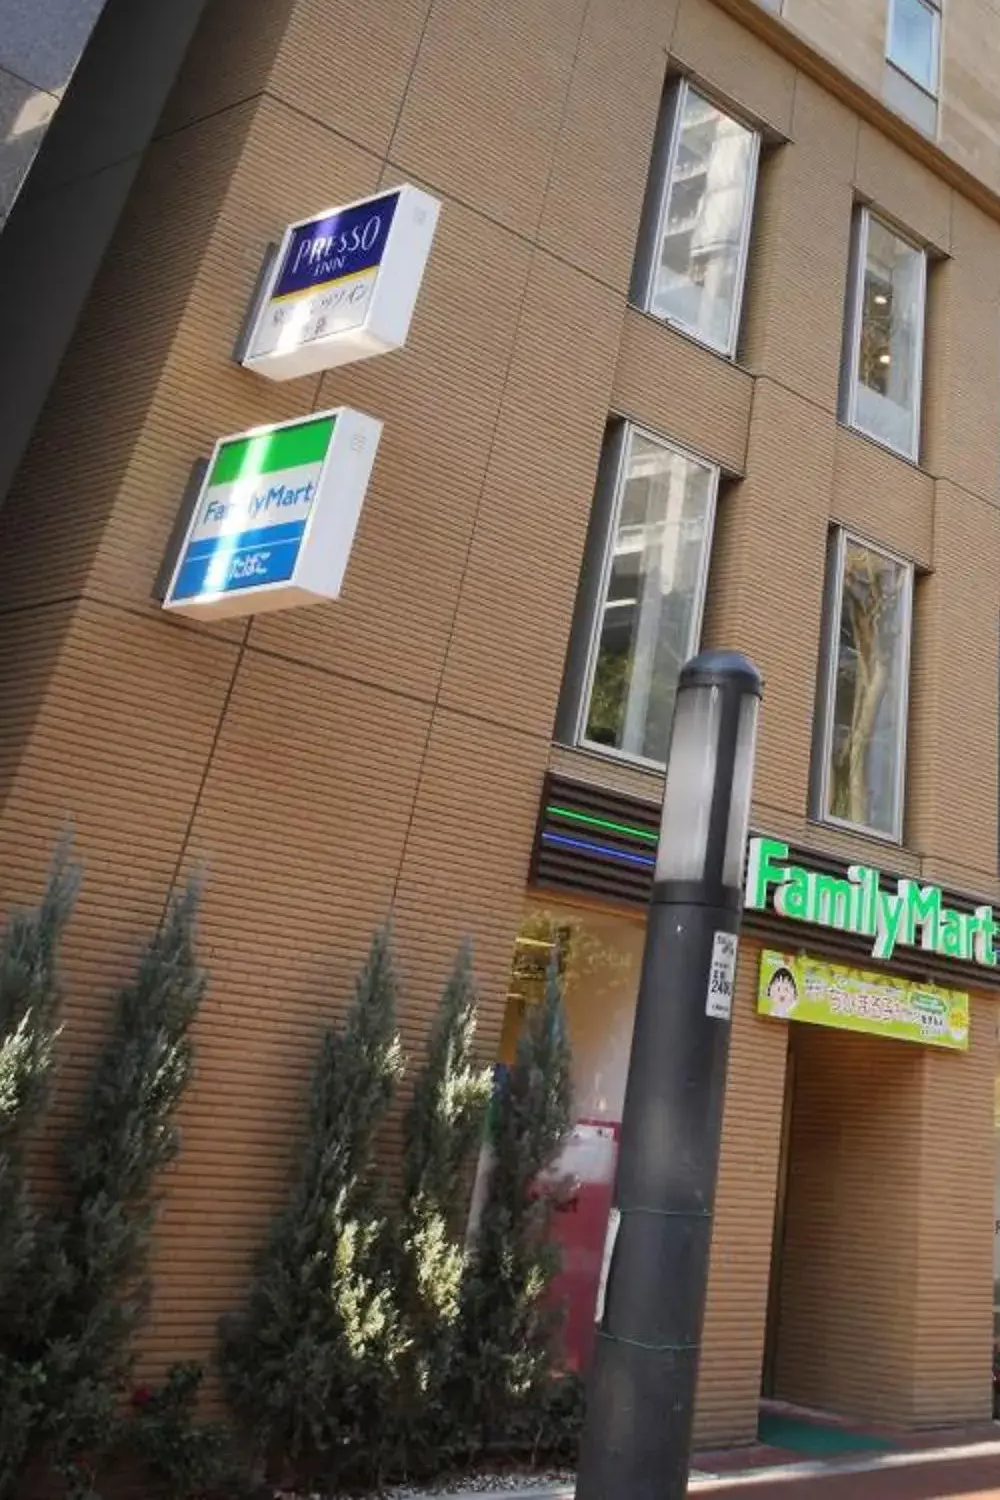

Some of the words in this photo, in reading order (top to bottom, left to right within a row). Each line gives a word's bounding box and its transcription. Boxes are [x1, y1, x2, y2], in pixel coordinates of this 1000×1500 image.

[291, 215, 381, 275] PRESSO
[314, 256, 346, 277] INN
[203, 482, 313, 525] FalyMart
[744, 837, 998, 966] FamilyMart
